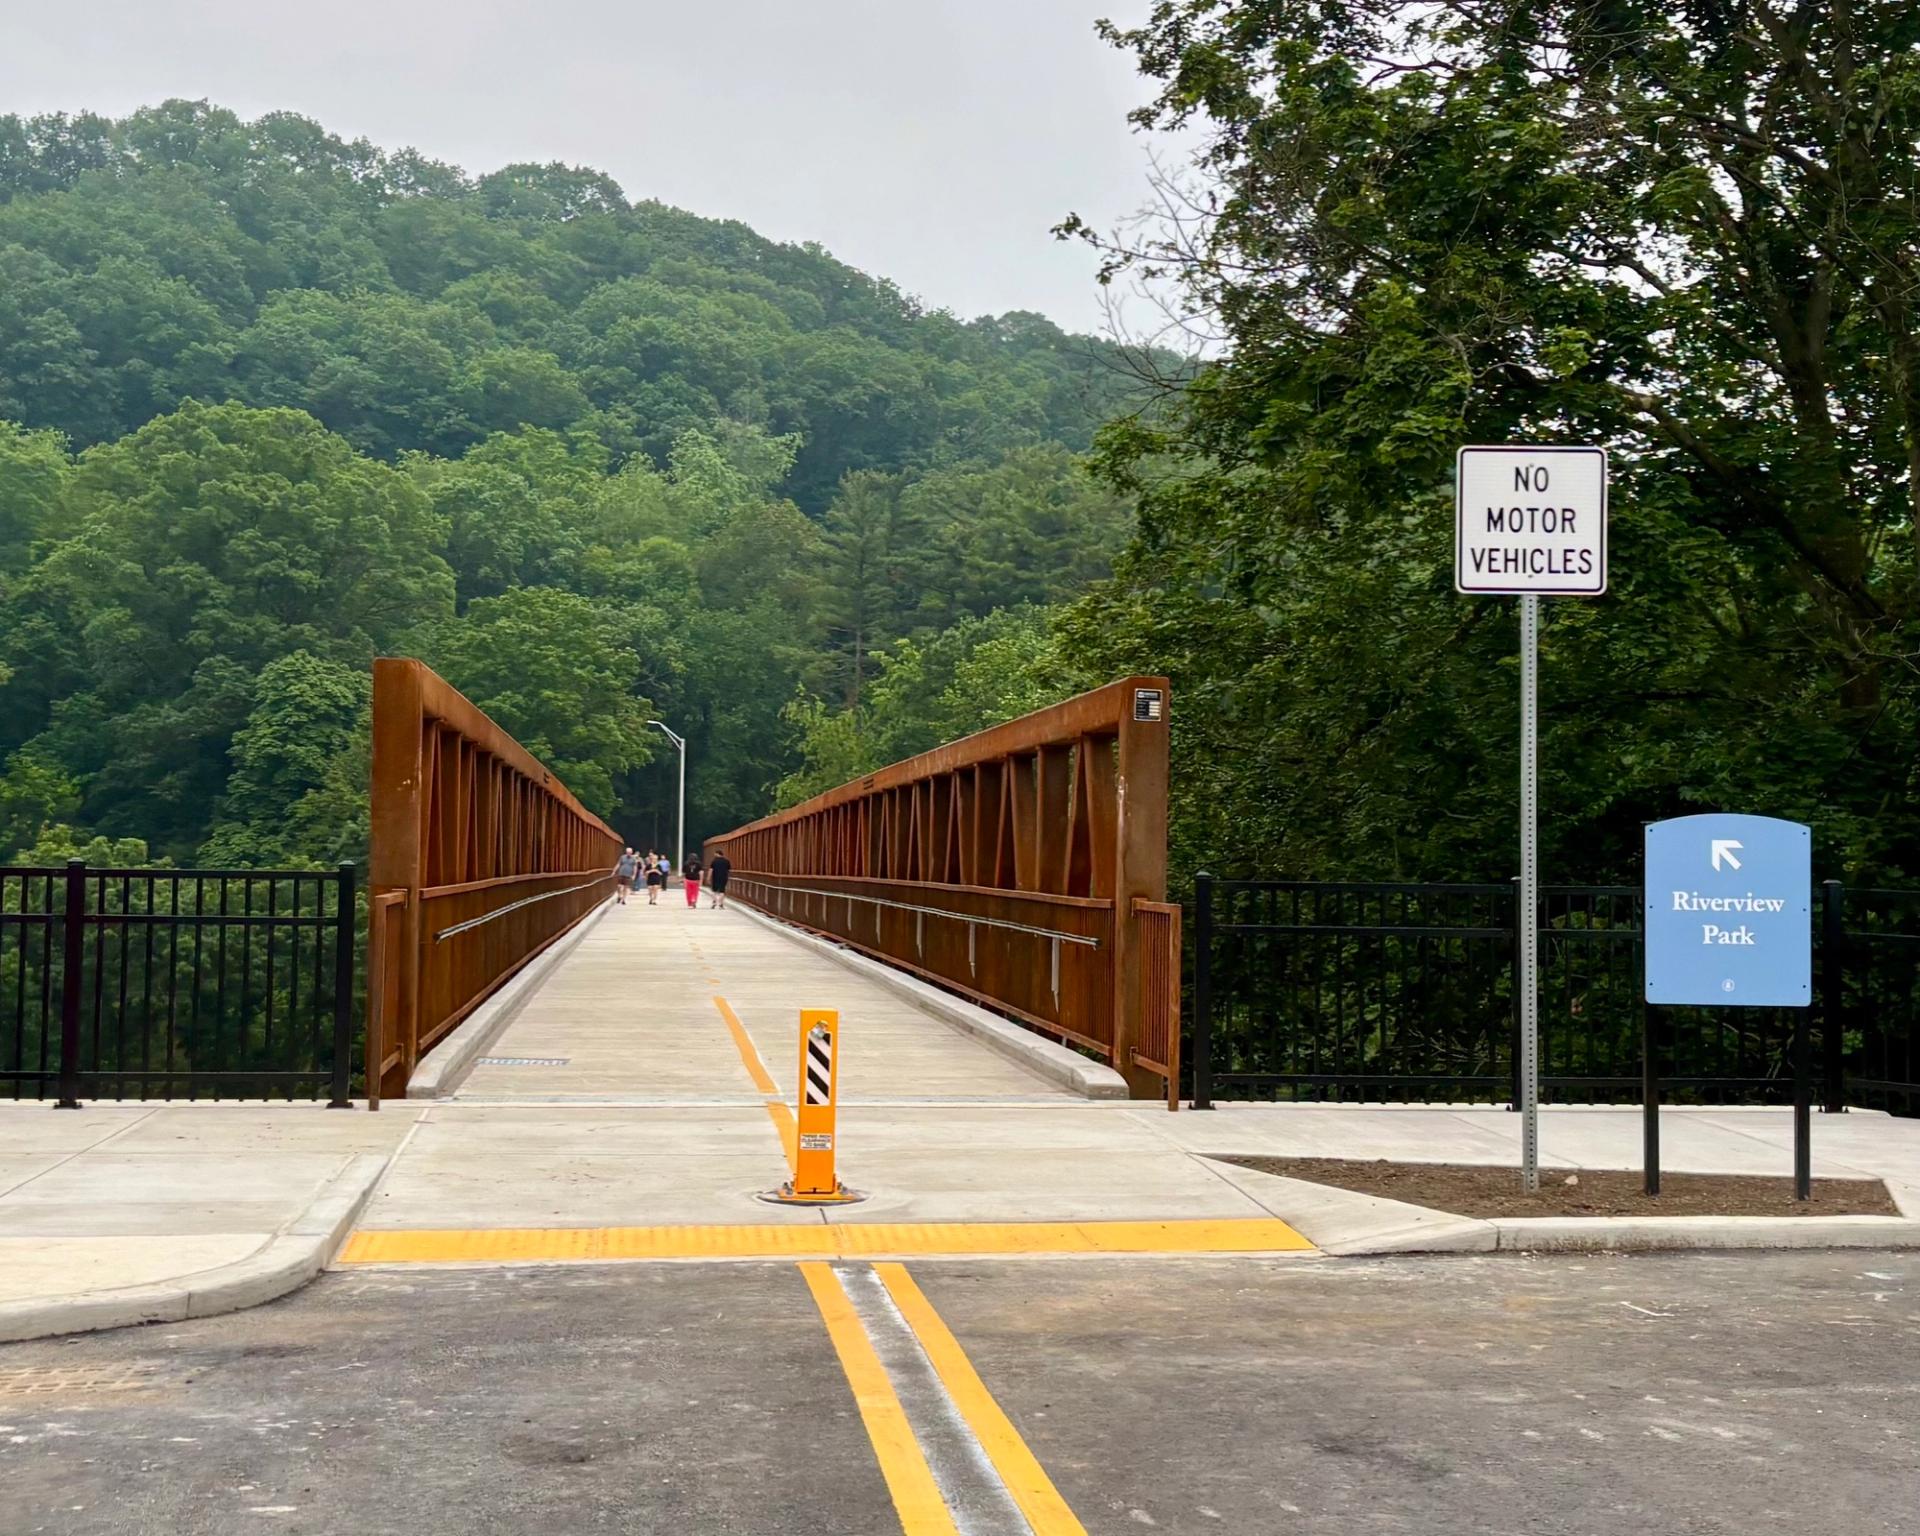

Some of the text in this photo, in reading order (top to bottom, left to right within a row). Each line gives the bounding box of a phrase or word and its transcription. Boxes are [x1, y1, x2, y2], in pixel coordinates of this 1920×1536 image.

[1514, 466, 1549, 492] NO
[1487, 507, 1576, 533] MOTOR
[1470, 548, 1593, 574] VEHICLES
[1672, 891, 1785, 912] Riverview
[1702, 924, 1755, 944] Park
